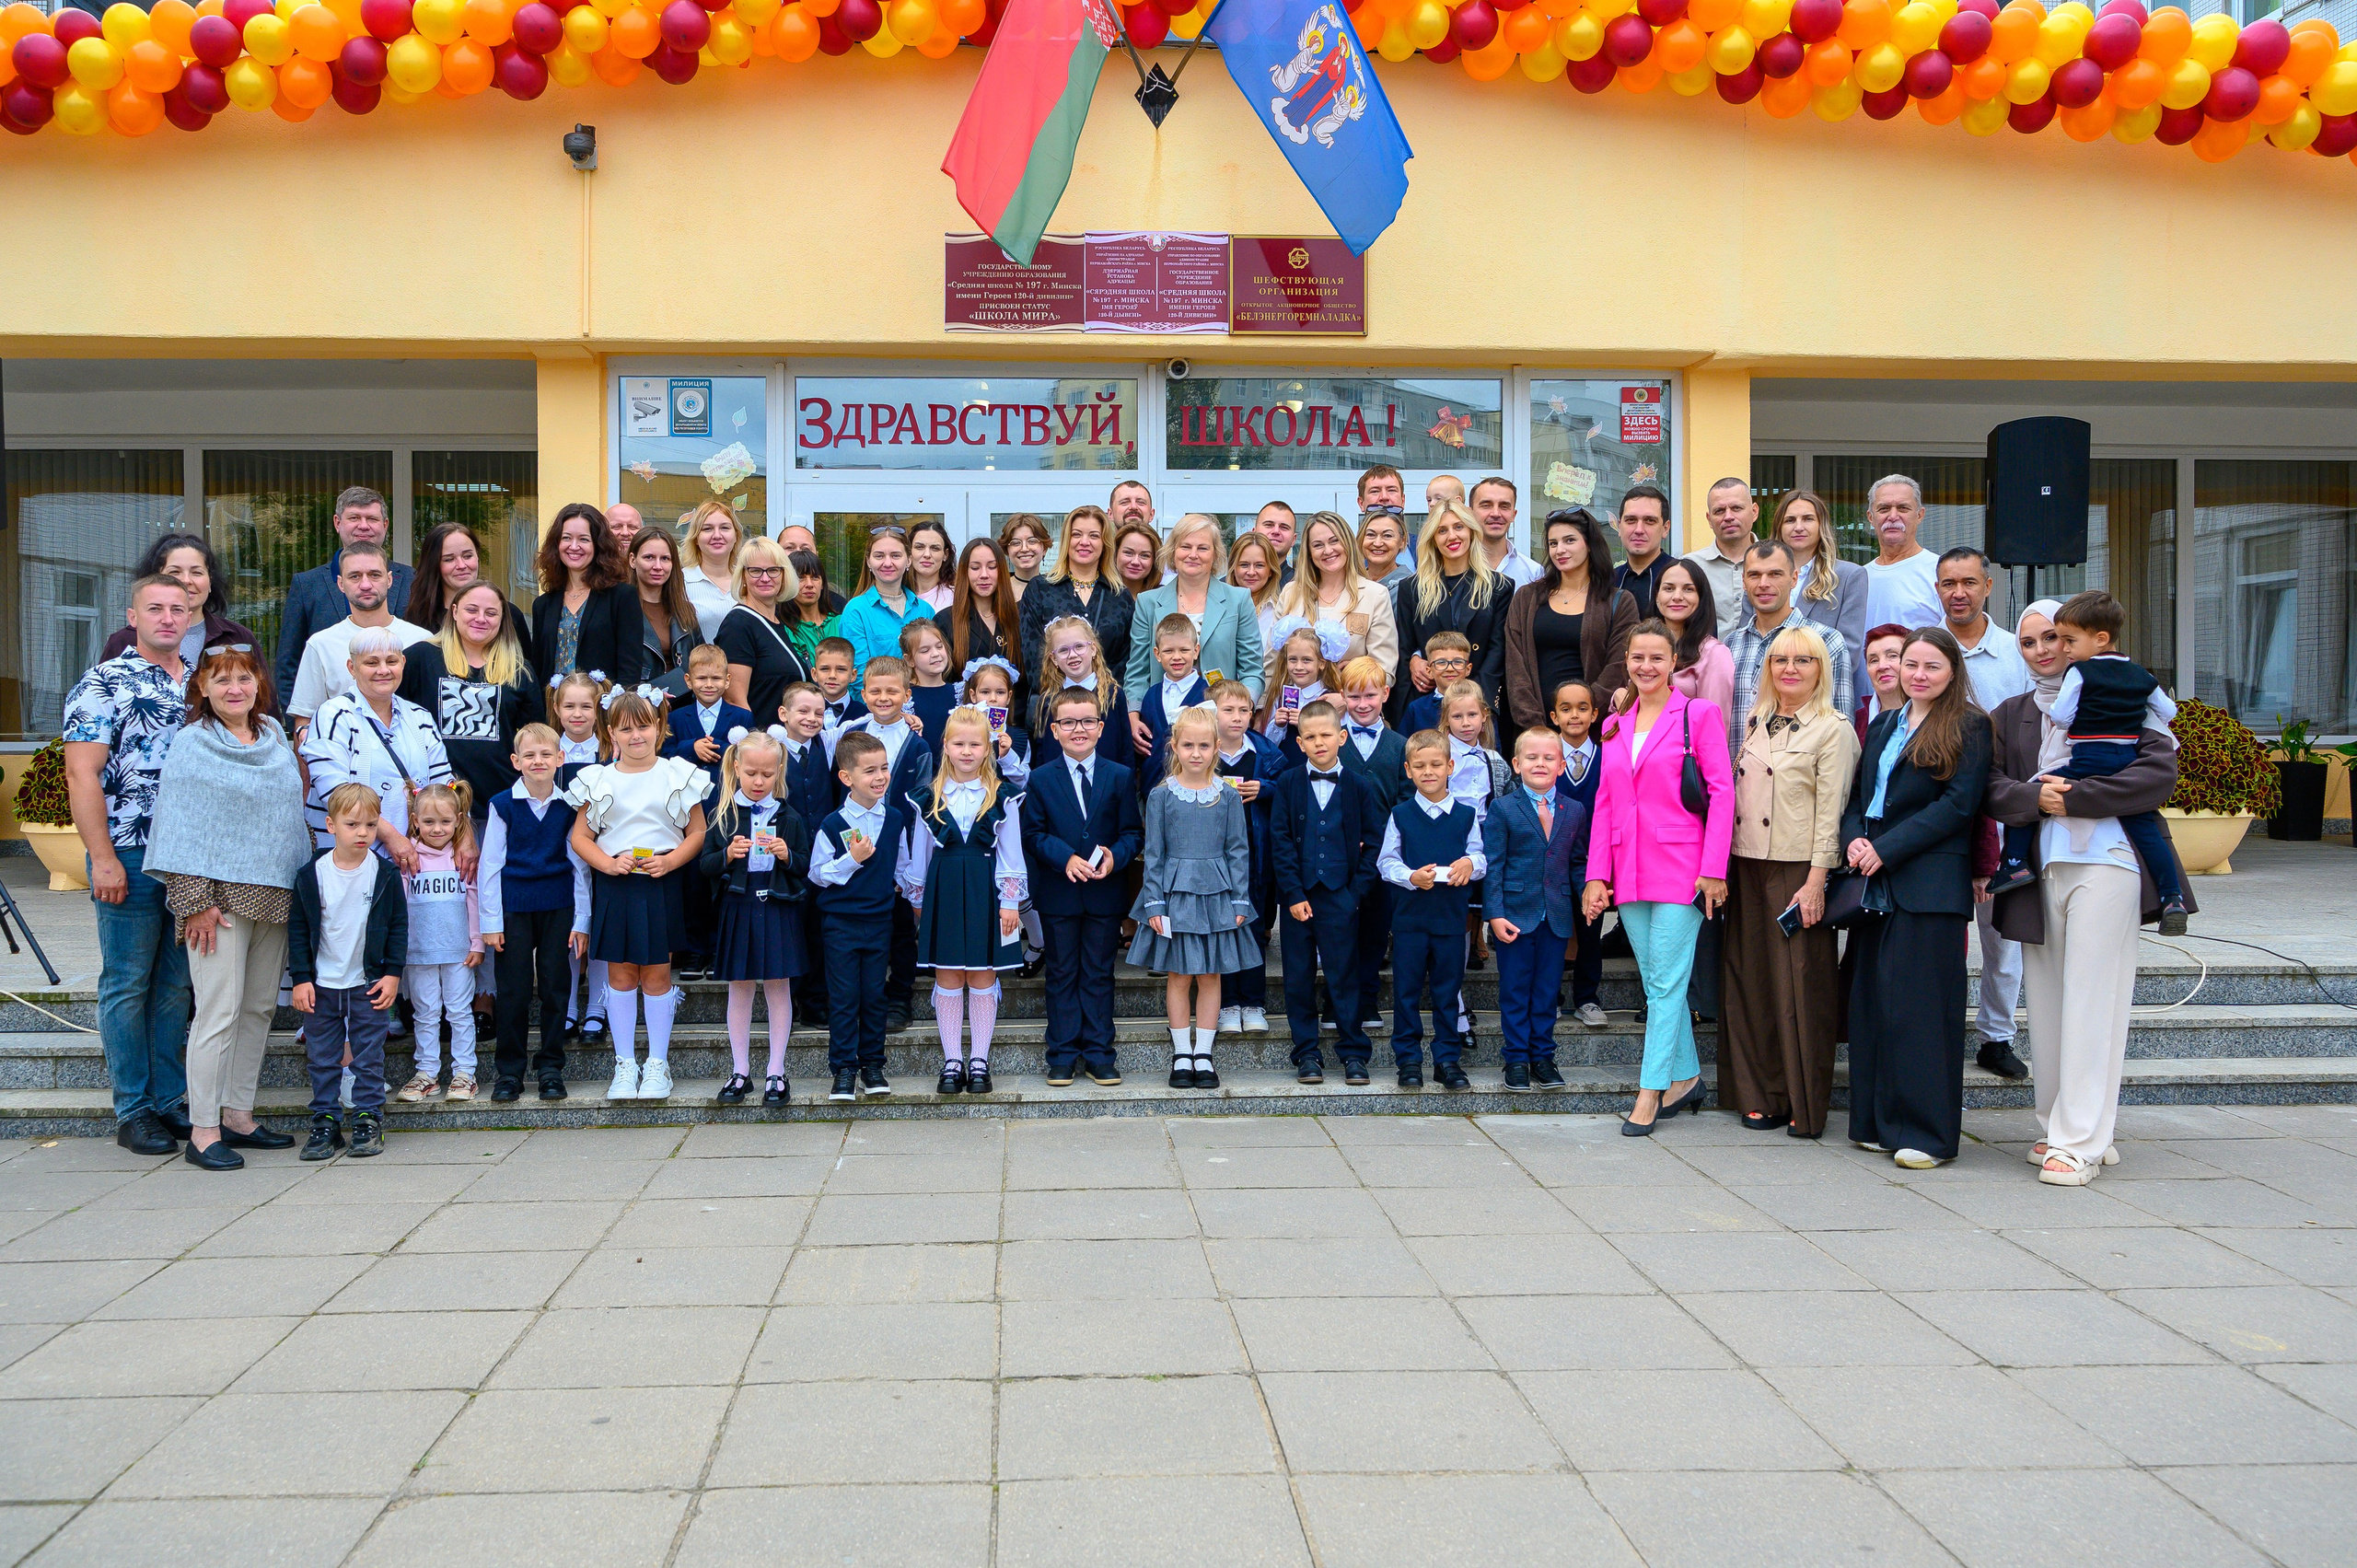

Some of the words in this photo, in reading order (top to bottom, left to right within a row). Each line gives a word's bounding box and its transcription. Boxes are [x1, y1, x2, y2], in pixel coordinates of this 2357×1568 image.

[1253, 276, 1344, 285] ШЕФСТВУЮЩАЯ
[1051, 282, 1082, 290] Минска
[983, 292, 1012, 300] Героев
[1259, 287, 1339, 296] ОРГАНИЗАЦИЯ
[969, 311, 1019, 320] «ШКОЛА
[1022, 311, 1061, 320] МИРА»
[1236, 312, 1362, 322] «БЕЛЭНЕРГОРЕМНАЛАДКА»
[799, 391, 1134, 455] ЗДРАВСТВУЙ,
[1624, 416, 1658, 427] ЗДЕСЬ
